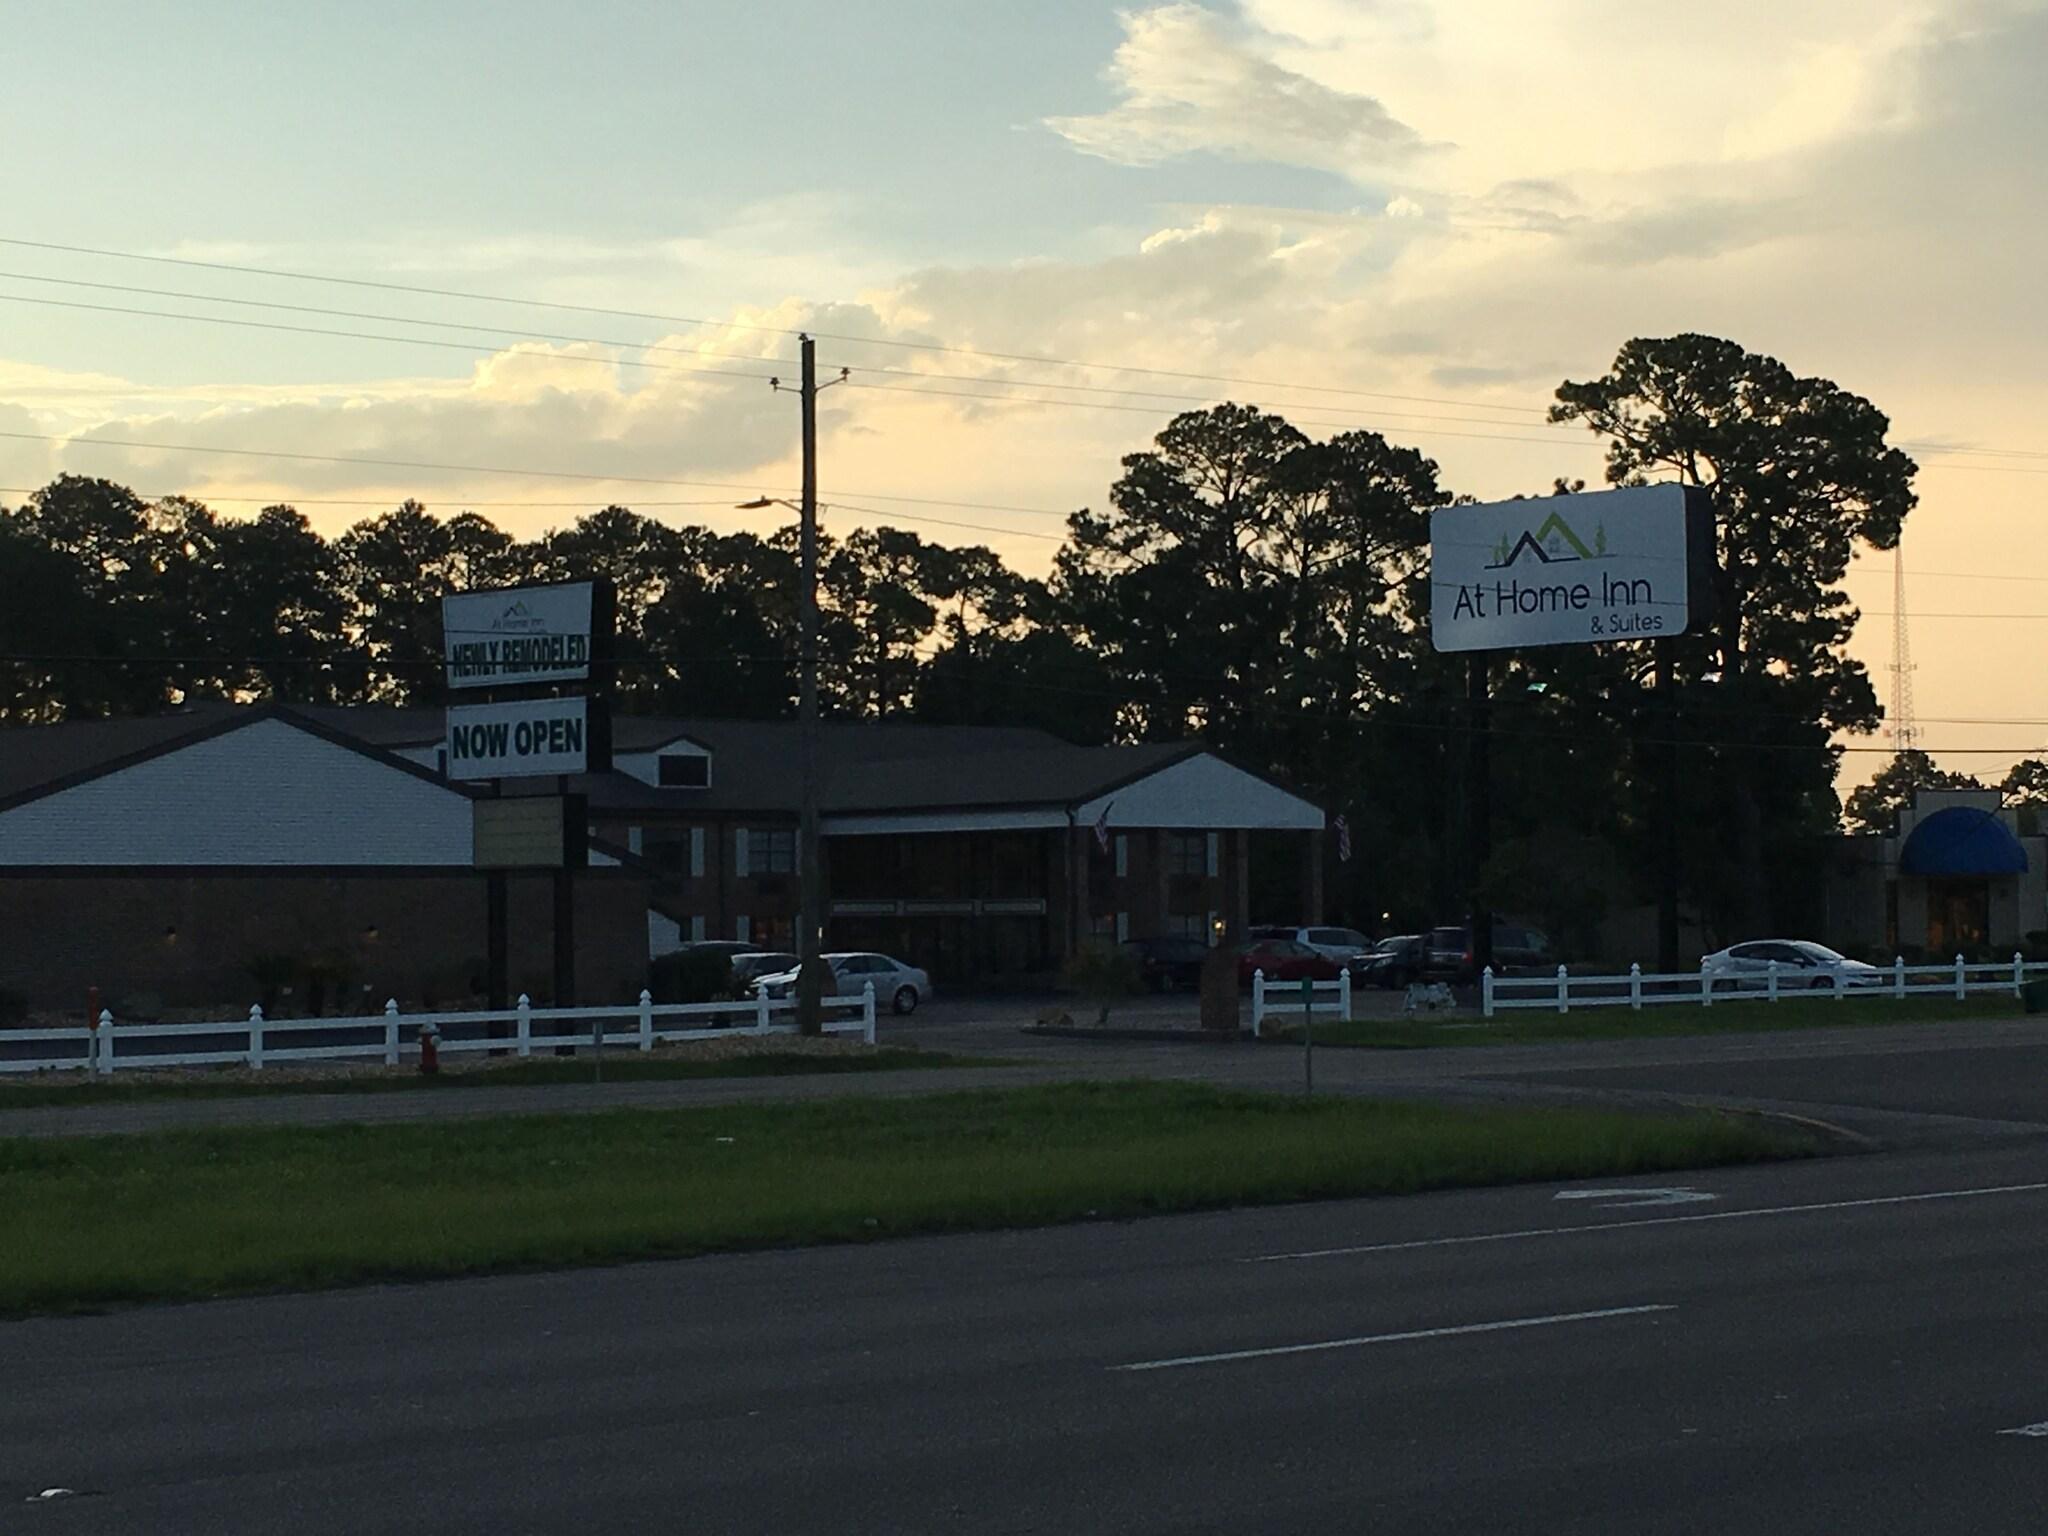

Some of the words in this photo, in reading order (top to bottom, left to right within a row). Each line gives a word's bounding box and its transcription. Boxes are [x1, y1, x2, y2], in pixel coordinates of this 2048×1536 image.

[1454, 584, 1486, 620] At
[1497, 580, 1590, 616] Home
[1603, 572, 1652, 607] Inn
[1591, 616, 1604, 635] &
[1609, 614, 1663, 633] Suites
[453, 641, 499, 677] NEWLY
[503, 634, 585, 674] REMODELED
[453, 723, 509, 759] NOW
[515, 718, 582, 755] OPEN
